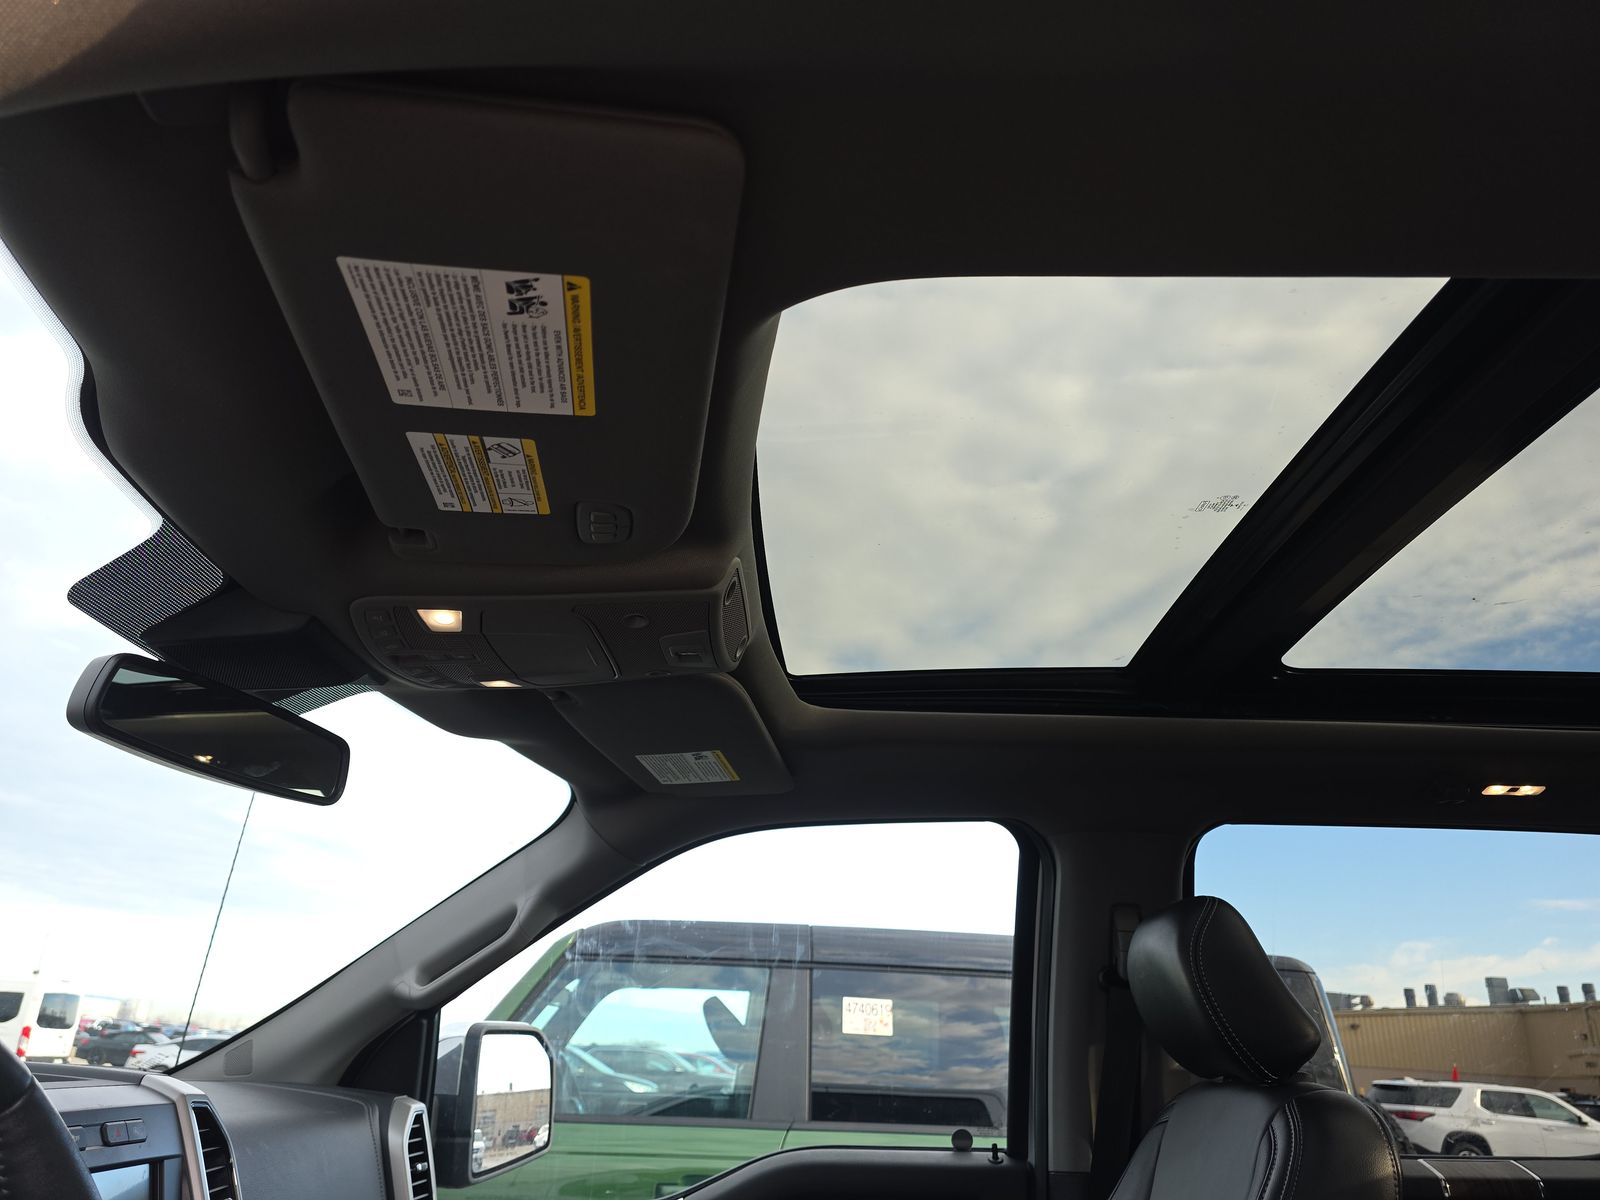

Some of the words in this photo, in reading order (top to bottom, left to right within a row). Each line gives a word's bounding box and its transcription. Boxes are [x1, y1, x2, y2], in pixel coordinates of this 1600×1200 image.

[477, 310, 486, 321] DES
[480, 322, 489, 336] SACS
[553, 330, 561, 343] EVEN
[555, 344, 563, 357] WITH
[556, 357, 565, 383] ADVANCED
